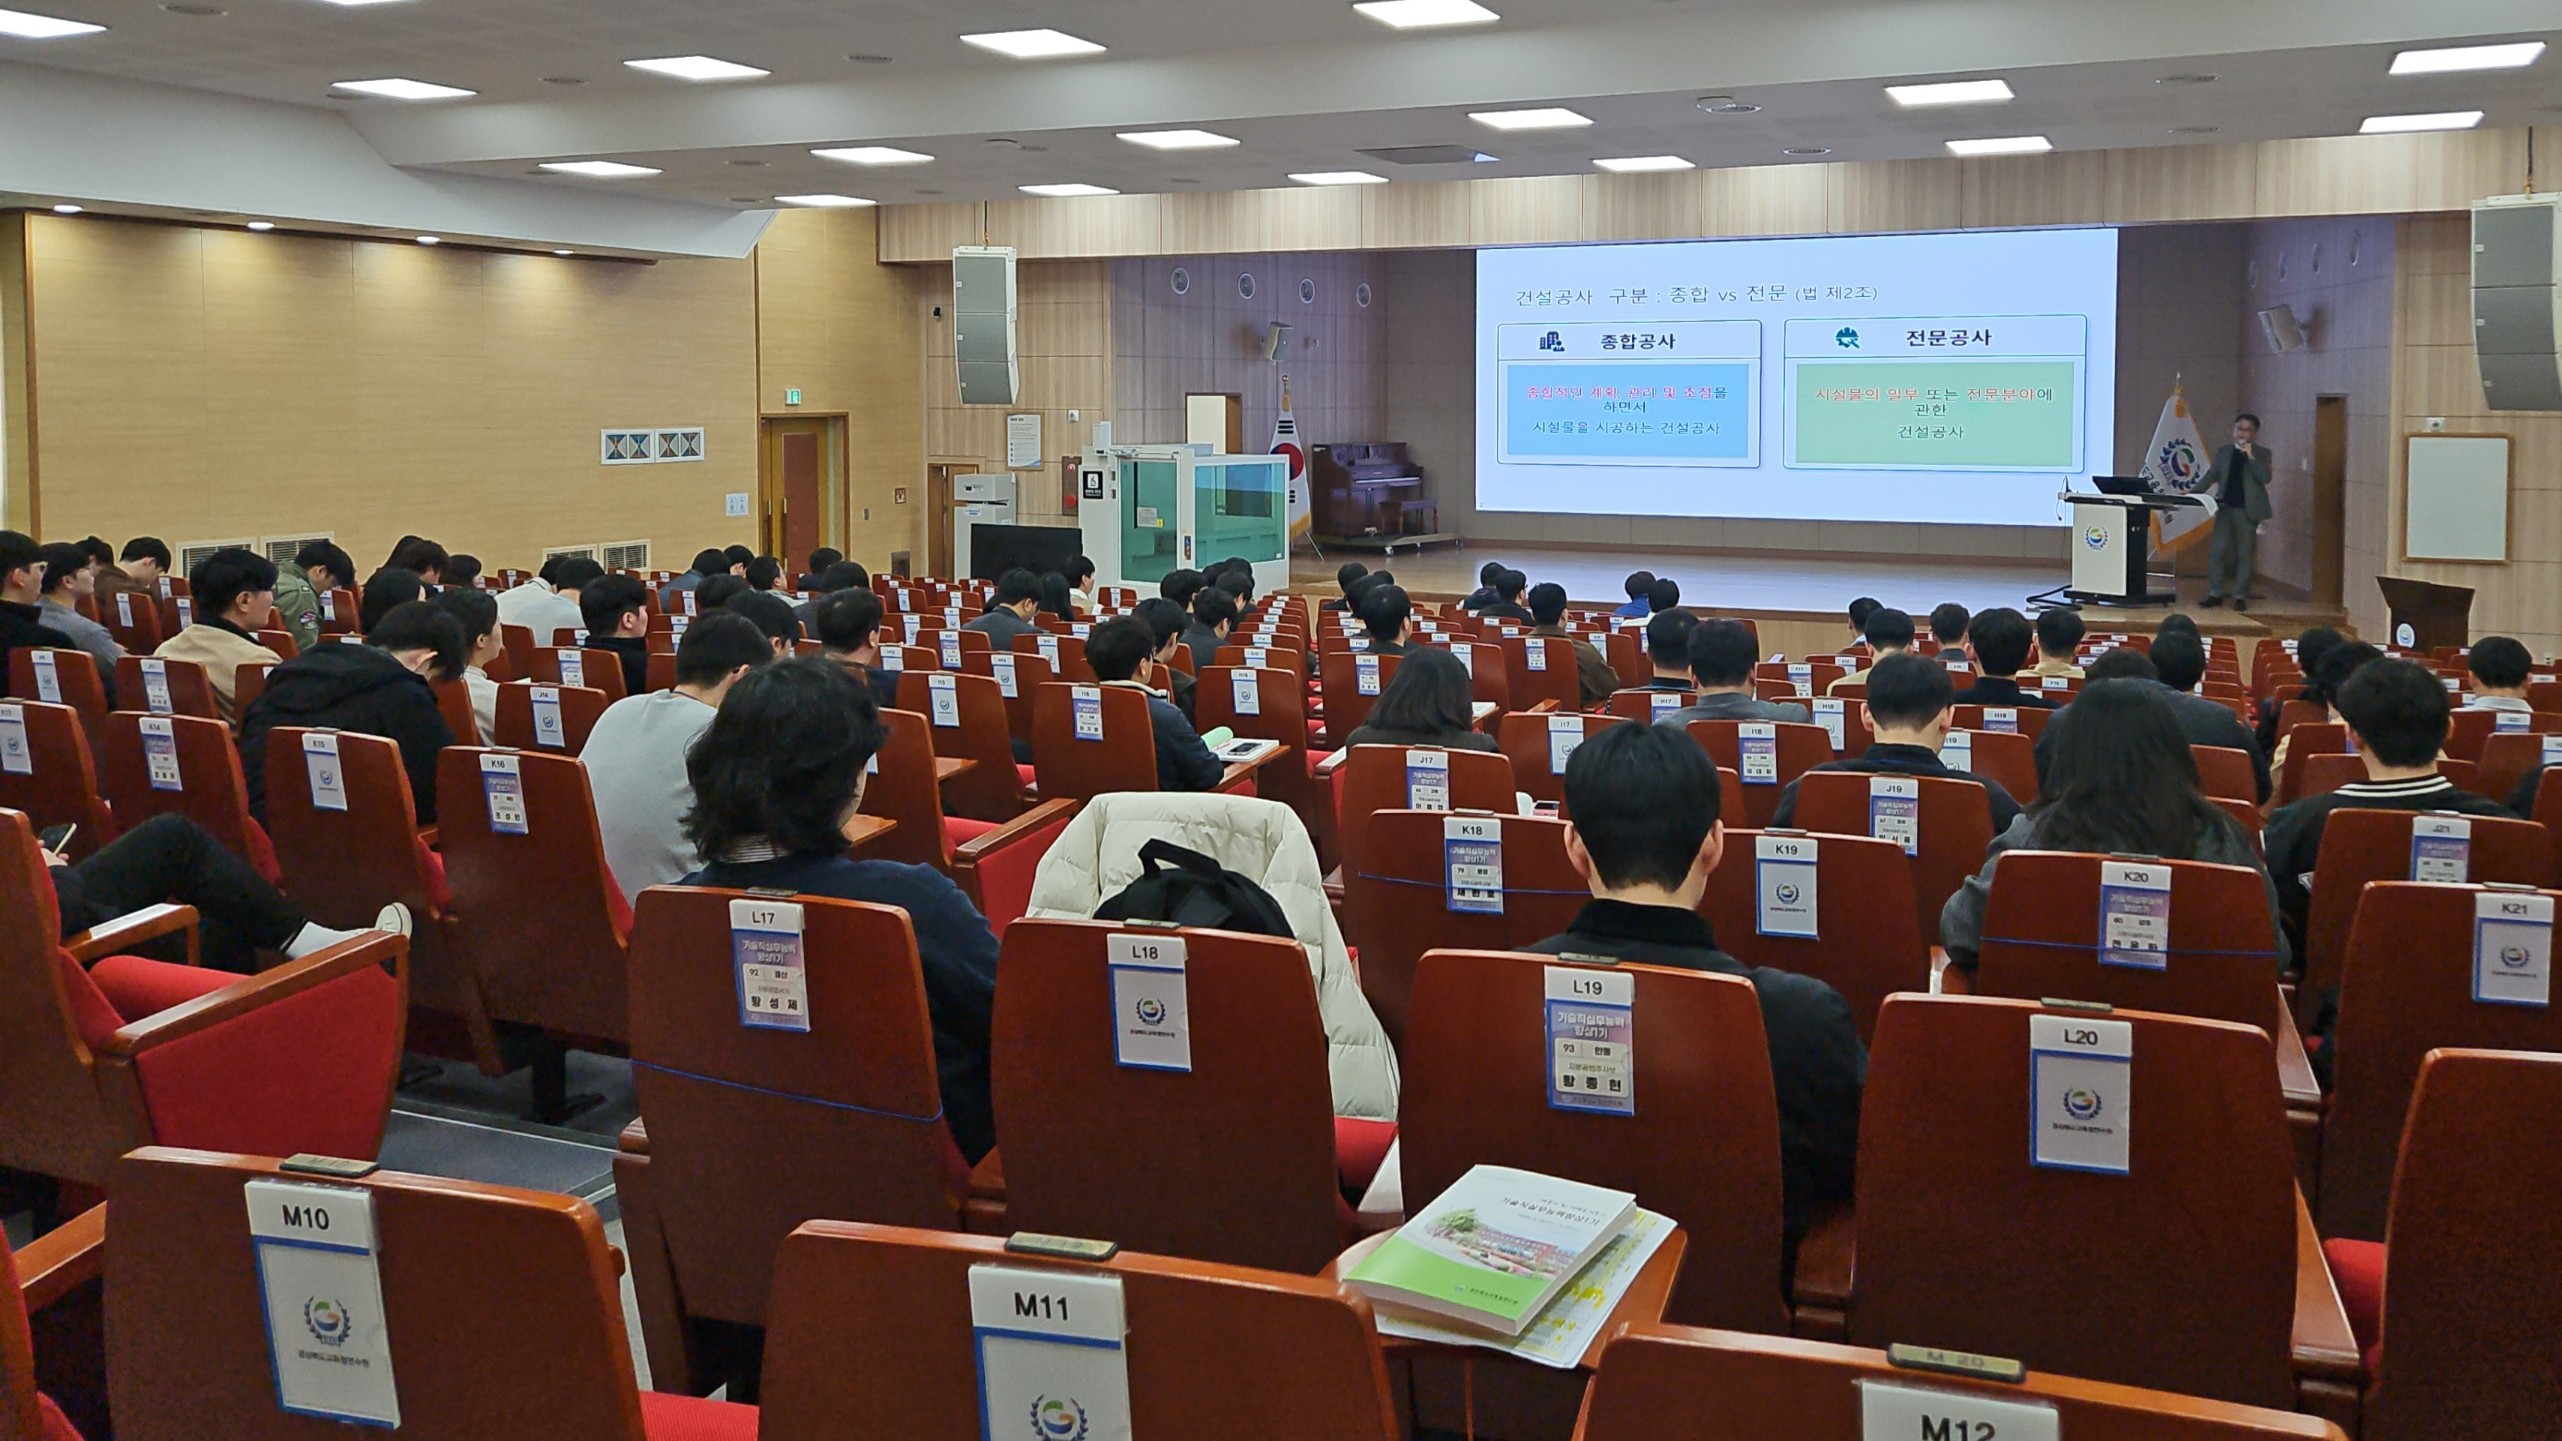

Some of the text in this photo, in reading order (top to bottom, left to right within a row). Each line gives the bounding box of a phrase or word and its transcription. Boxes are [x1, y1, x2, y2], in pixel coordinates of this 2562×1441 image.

[1516, 289, 1594, 306] 건설공사
[1609, 288, 1648, 305] 구분
[1669, 286, 1709, 303] 종합
[1718, 290, 1737, 301] vs
[1746, 285, 1787, 302] 전문
[1795, 286, 1817, 302] (법
[1826, 285, 1877, 301] 제2조)
[1600, 333, 1676, 350] 종합공사
[1906, 329, 1993, 346] 전문공사
[1526, 386, 1583, 399] 종합적인
[1627, 386, 1656, 399] 관리
[1816, 387, 2053, 402] 시설물의 일부 또는 전문분야에
[1603, 400, 1647, 414] 하면서
[1914, 403, 1947, 417] 관한
[1533, 421, 1720, 435] 시설물을 시공하는 건설공사
[1898, 425, 1965, 439] 건설공사
[539, 691, 550, 699] J14
[1560, 719, 1571, 728] I17
[491, 759, 505, 768] K16
[1420, 756, 1433, 764] J17
[1886, 784, 1903, 794] J19
[1462, 825, 1483, 836] K18
[1775, 844, 1798, 855] K19
[2124, 871, 2149, 883] K20
[2501, 902, 2528, 914] K21
[751, 910, 775, 924] L17
[1132, 945, 1159, 960] L18
[1573, 979, 1603, 995] L19
[1558, 1011, 1625, 1029] 기술직실무능력
[1575, 1024, 1608, 1040] 향상1기
[2064, 1028, 2099, 1046] L20
[1563, 1043, 1575, 1053] 93
[282, 1204, 330, 1231] M10
[1014, 1291, 1069, 1321] M11
[1921, 1414, 1995, 1441] M12
